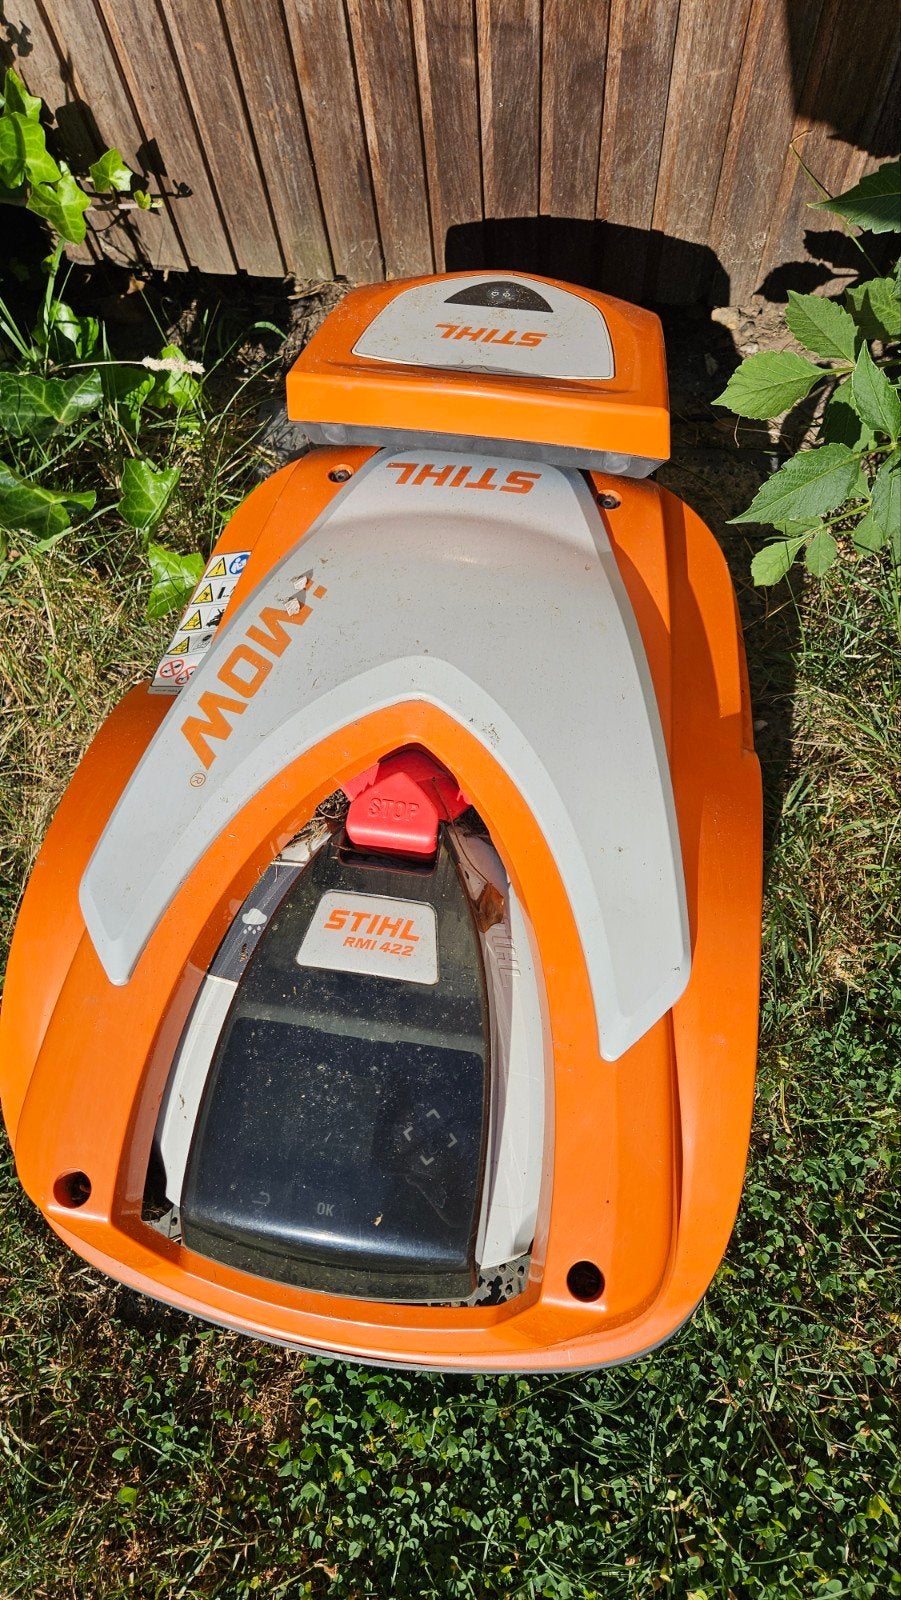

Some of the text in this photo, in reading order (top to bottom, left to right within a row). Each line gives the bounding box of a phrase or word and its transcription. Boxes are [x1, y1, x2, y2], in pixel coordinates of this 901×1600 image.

[435, 323, 548, 348] STIHL
[386, 462, 542, 495] STIHL
[368, 797, 420, 822] STOP
[324, 909, 420, 942] STIHL
[343, 936, 415, 957] RMI 422
[316, 1202, 334, 1216] OK
